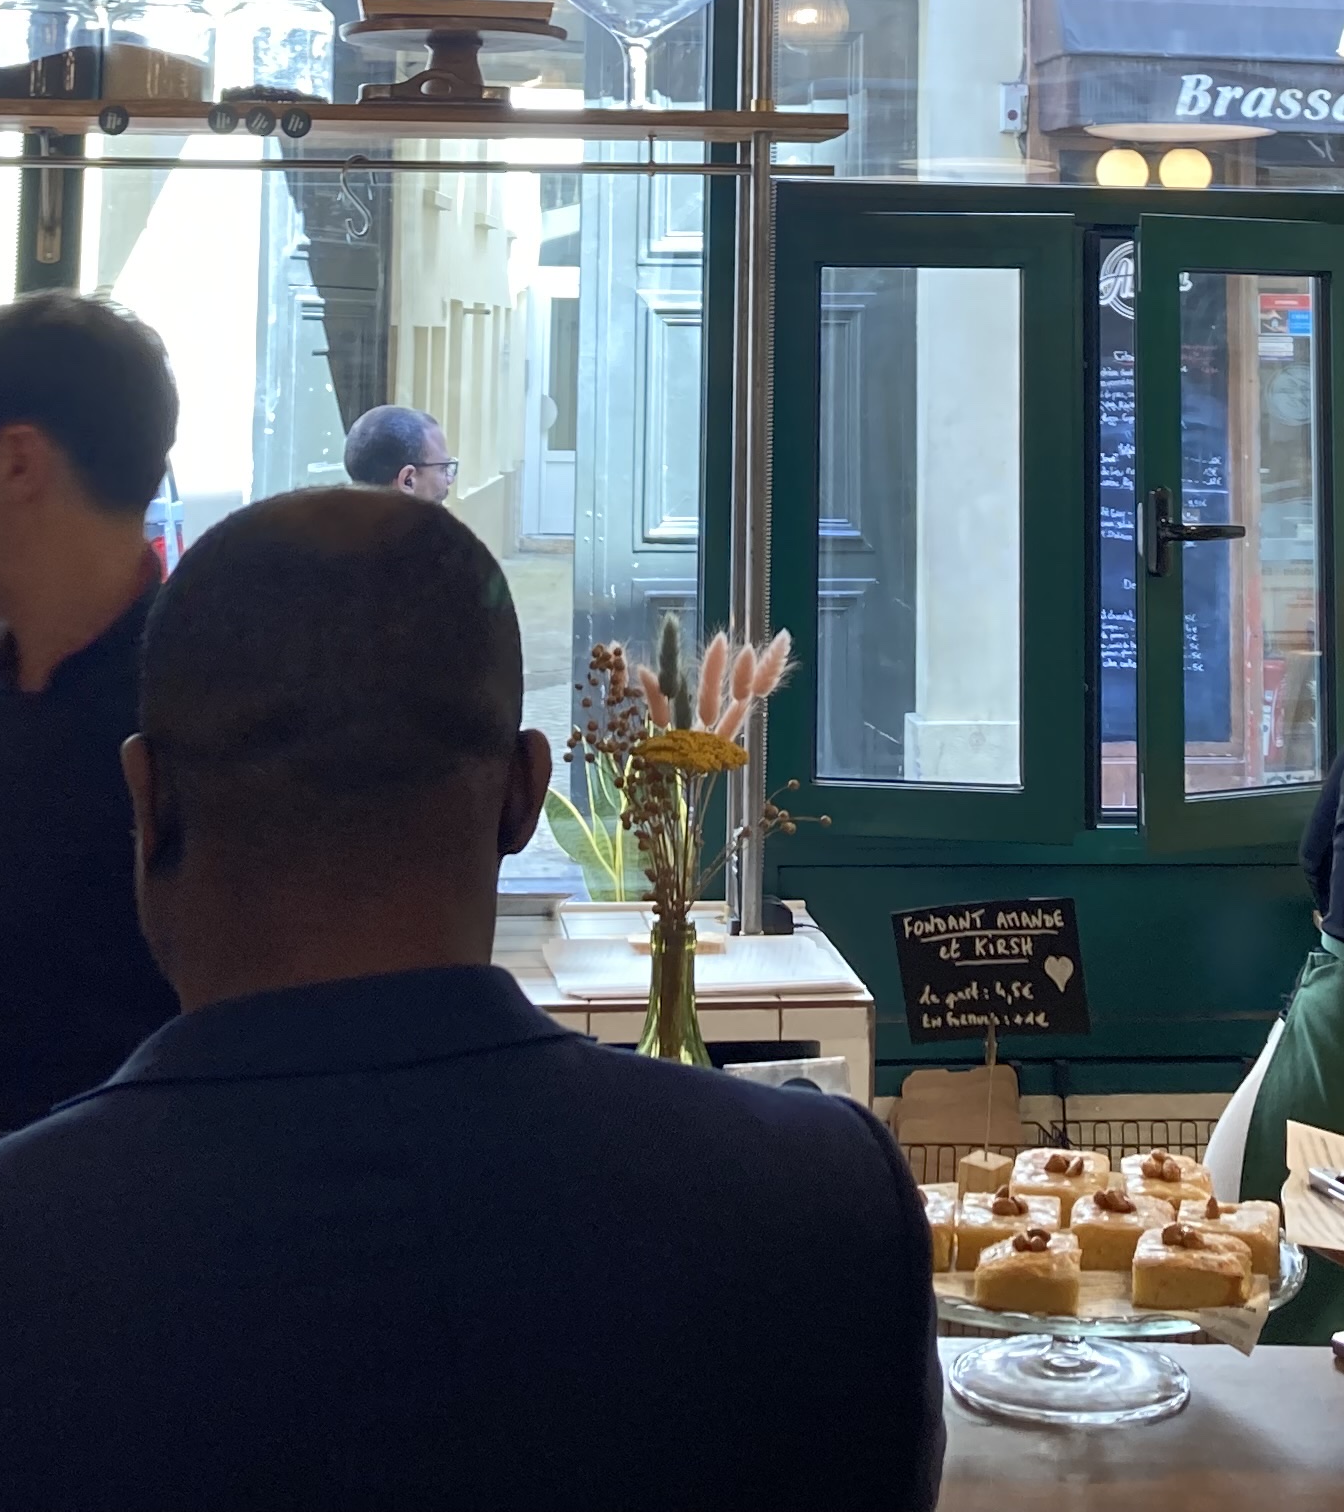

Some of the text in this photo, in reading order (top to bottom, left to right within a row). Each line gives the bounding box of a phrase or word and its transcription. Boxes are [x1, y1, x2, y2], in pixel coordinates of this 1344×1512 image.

[903, 908, 1065, 939] FONDANT AMANDE
[939, 938, 961, 960] et
